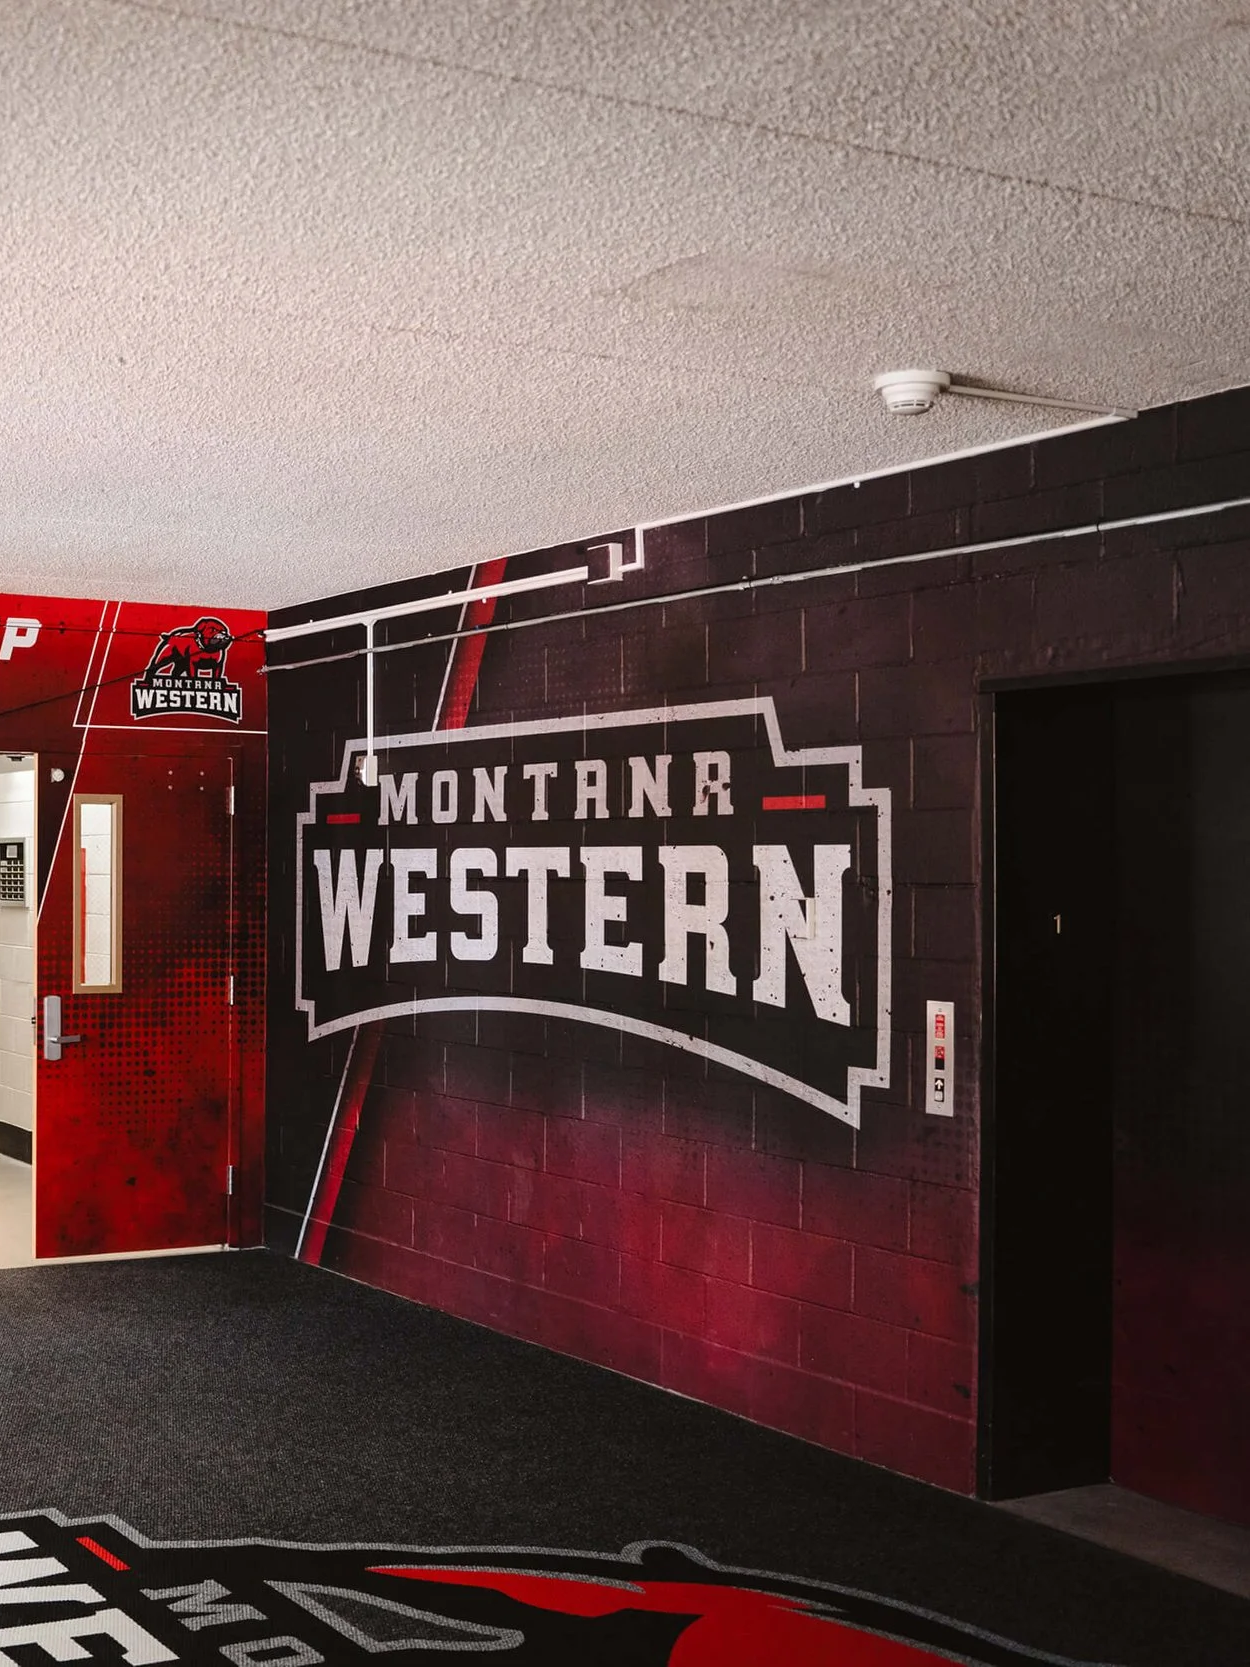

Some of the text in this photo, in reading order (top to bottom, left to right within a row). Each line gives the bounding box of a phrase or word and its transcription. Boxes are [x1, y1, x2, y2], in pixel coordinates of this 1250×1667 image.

[152, 678, 222, 690] MONTANA
[135, 689, 238, 714] WESTERN
[377, 751, 734, 825] MONTANA
[313, 845, 851, 1026] WESTERN
[1053, 914, 1062, 934] 1
